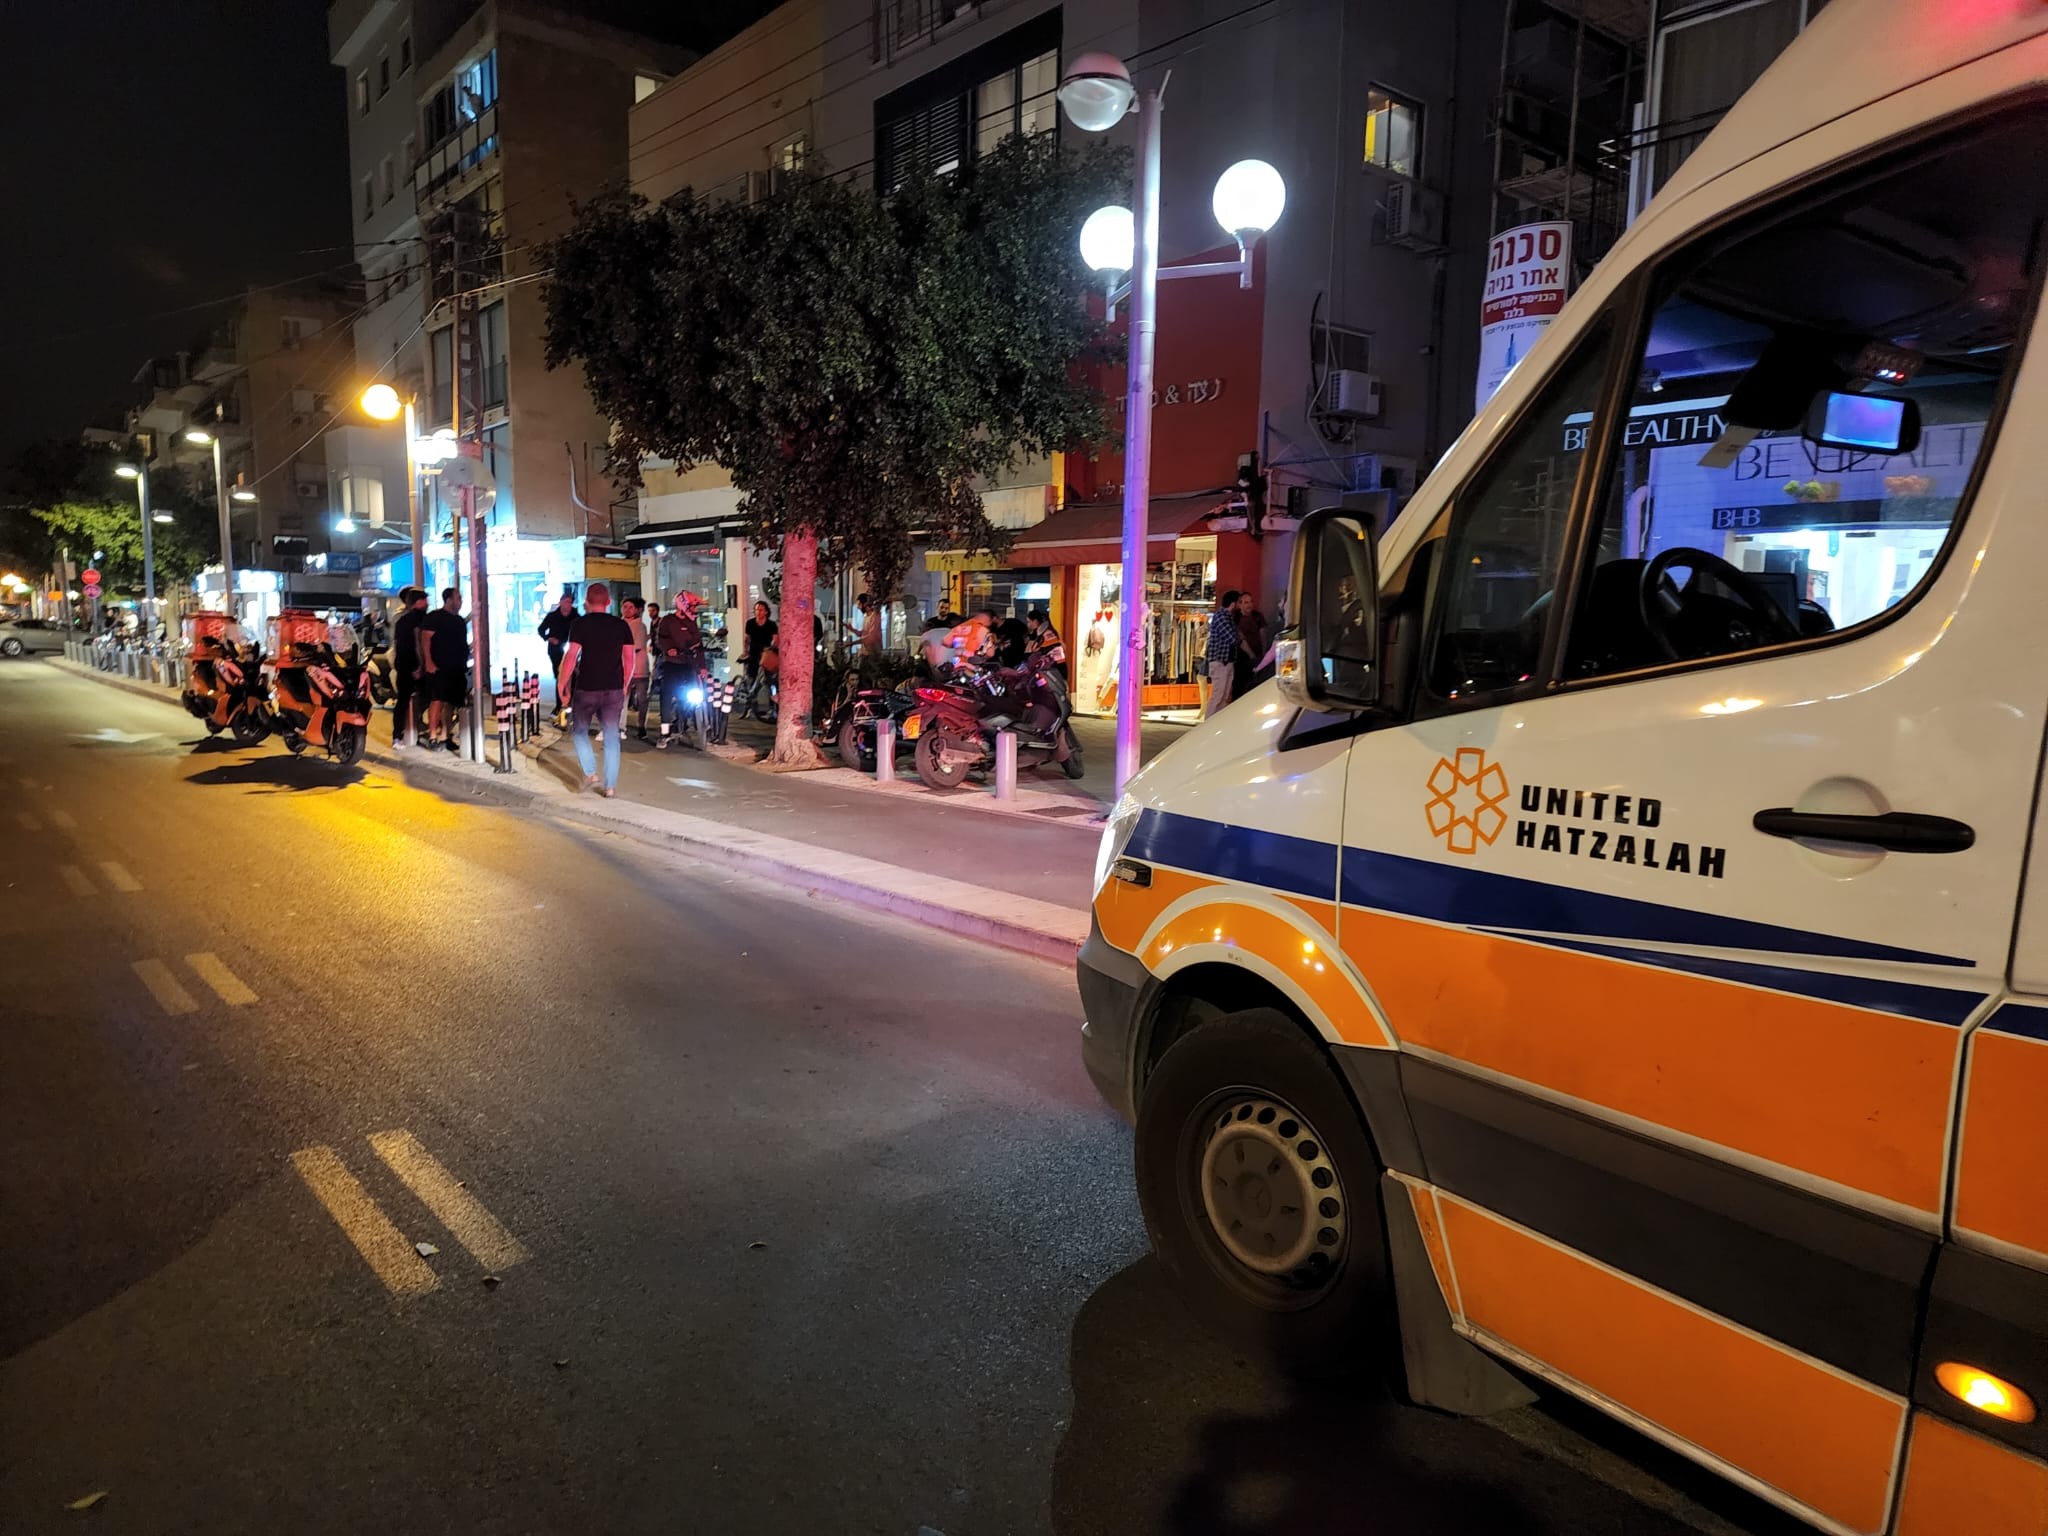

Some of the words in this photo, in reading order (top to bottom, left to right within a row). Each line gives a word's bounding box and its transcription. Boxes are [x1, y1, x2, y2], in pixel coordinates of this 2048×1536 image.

[1490, 229, 1562, 273] סכנה
[1488, 275, 1515, 296] בניה
[1520, 267, 1559, 288] אתר
[1164, 385, 1180, 405] &
[1623, 413, 1730, 446] EALTHY
[1735, 441, 1794, 482] BE
[1716, 508, 1762, 529] BHB
[1520, 784, 1662, 829] UNITED
[1516, 820, 1727, 879] HATZALAH
